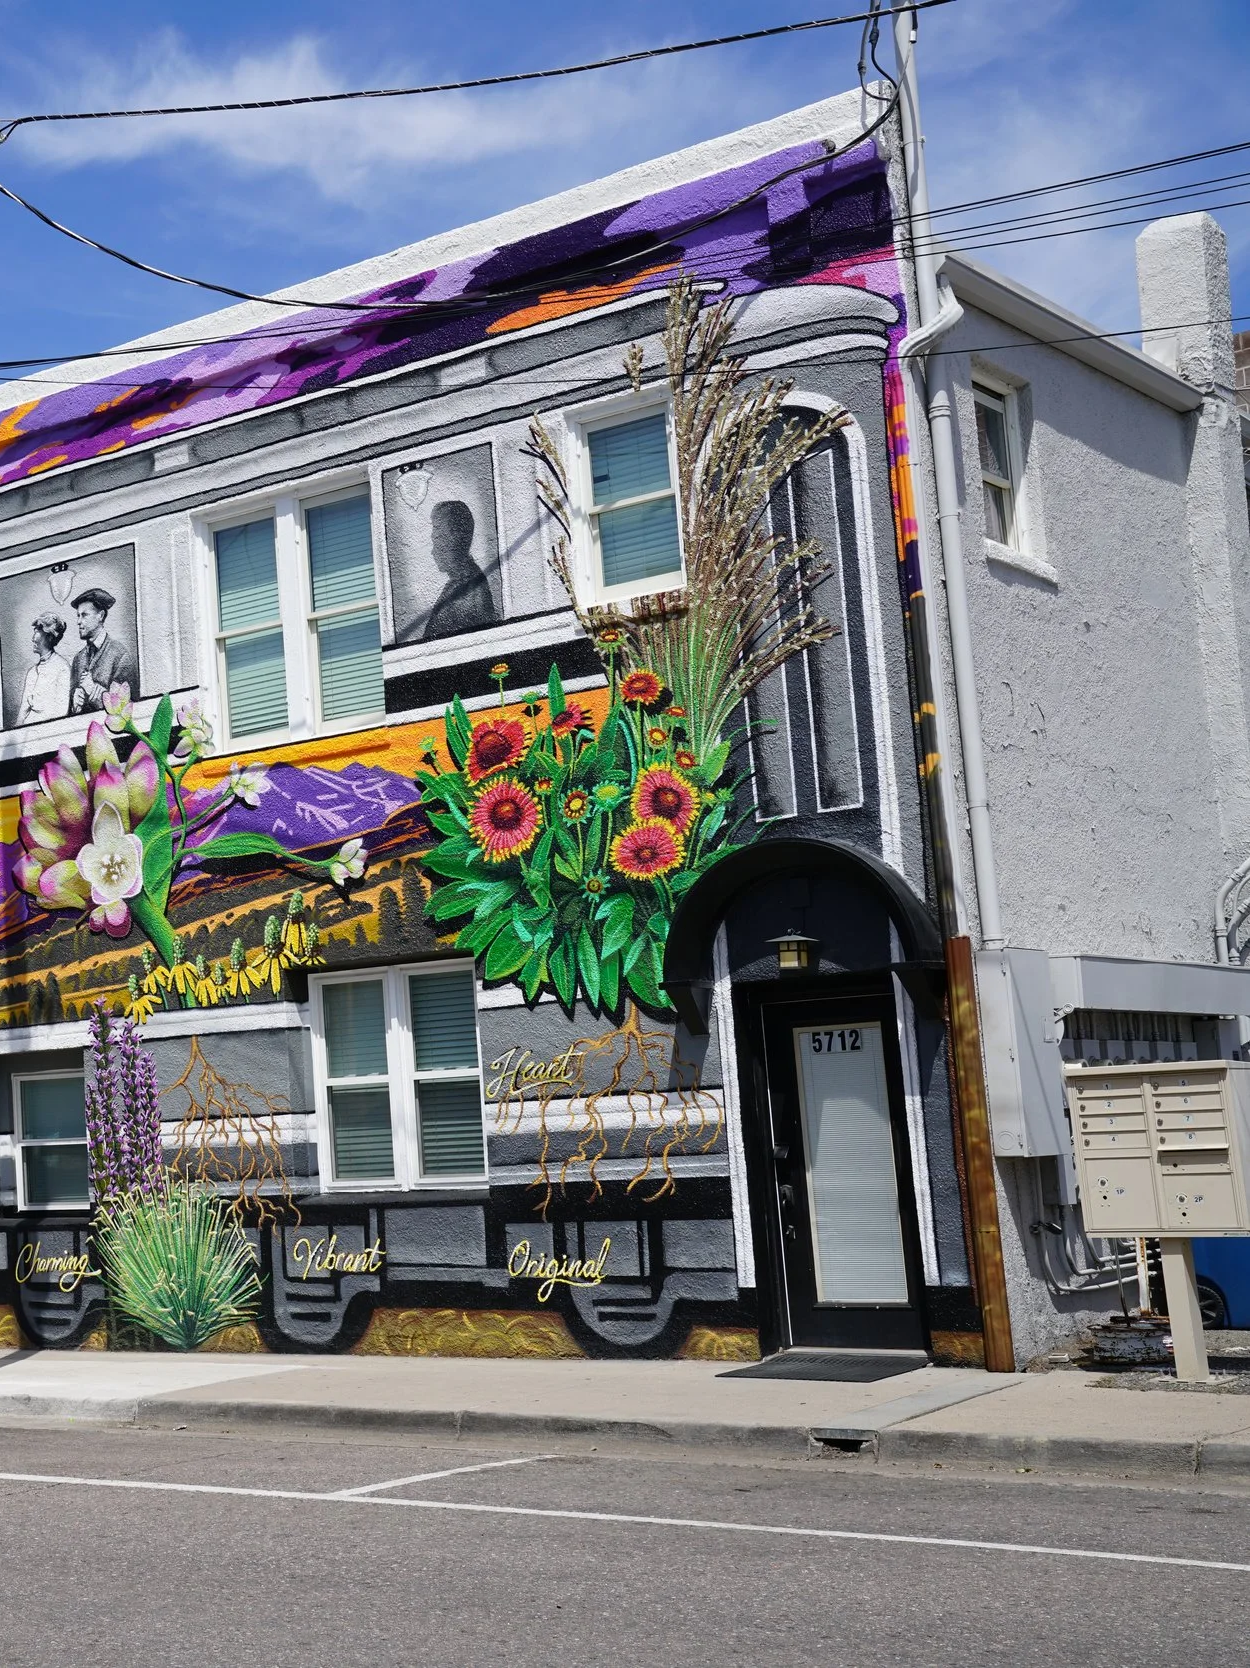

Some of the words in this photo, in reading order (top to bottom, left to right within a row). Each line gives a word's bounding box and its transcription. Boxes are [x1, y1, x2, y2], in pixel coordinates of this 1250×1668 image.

[811, 1029, 861, 1053] 5712
[485, 1043, 583, 1098] Heart
[15, 1240, 102, 1293] Charming
[293, 1234, 386, 1280] Vibrant
[507, 1237, 611, 1303] Original
